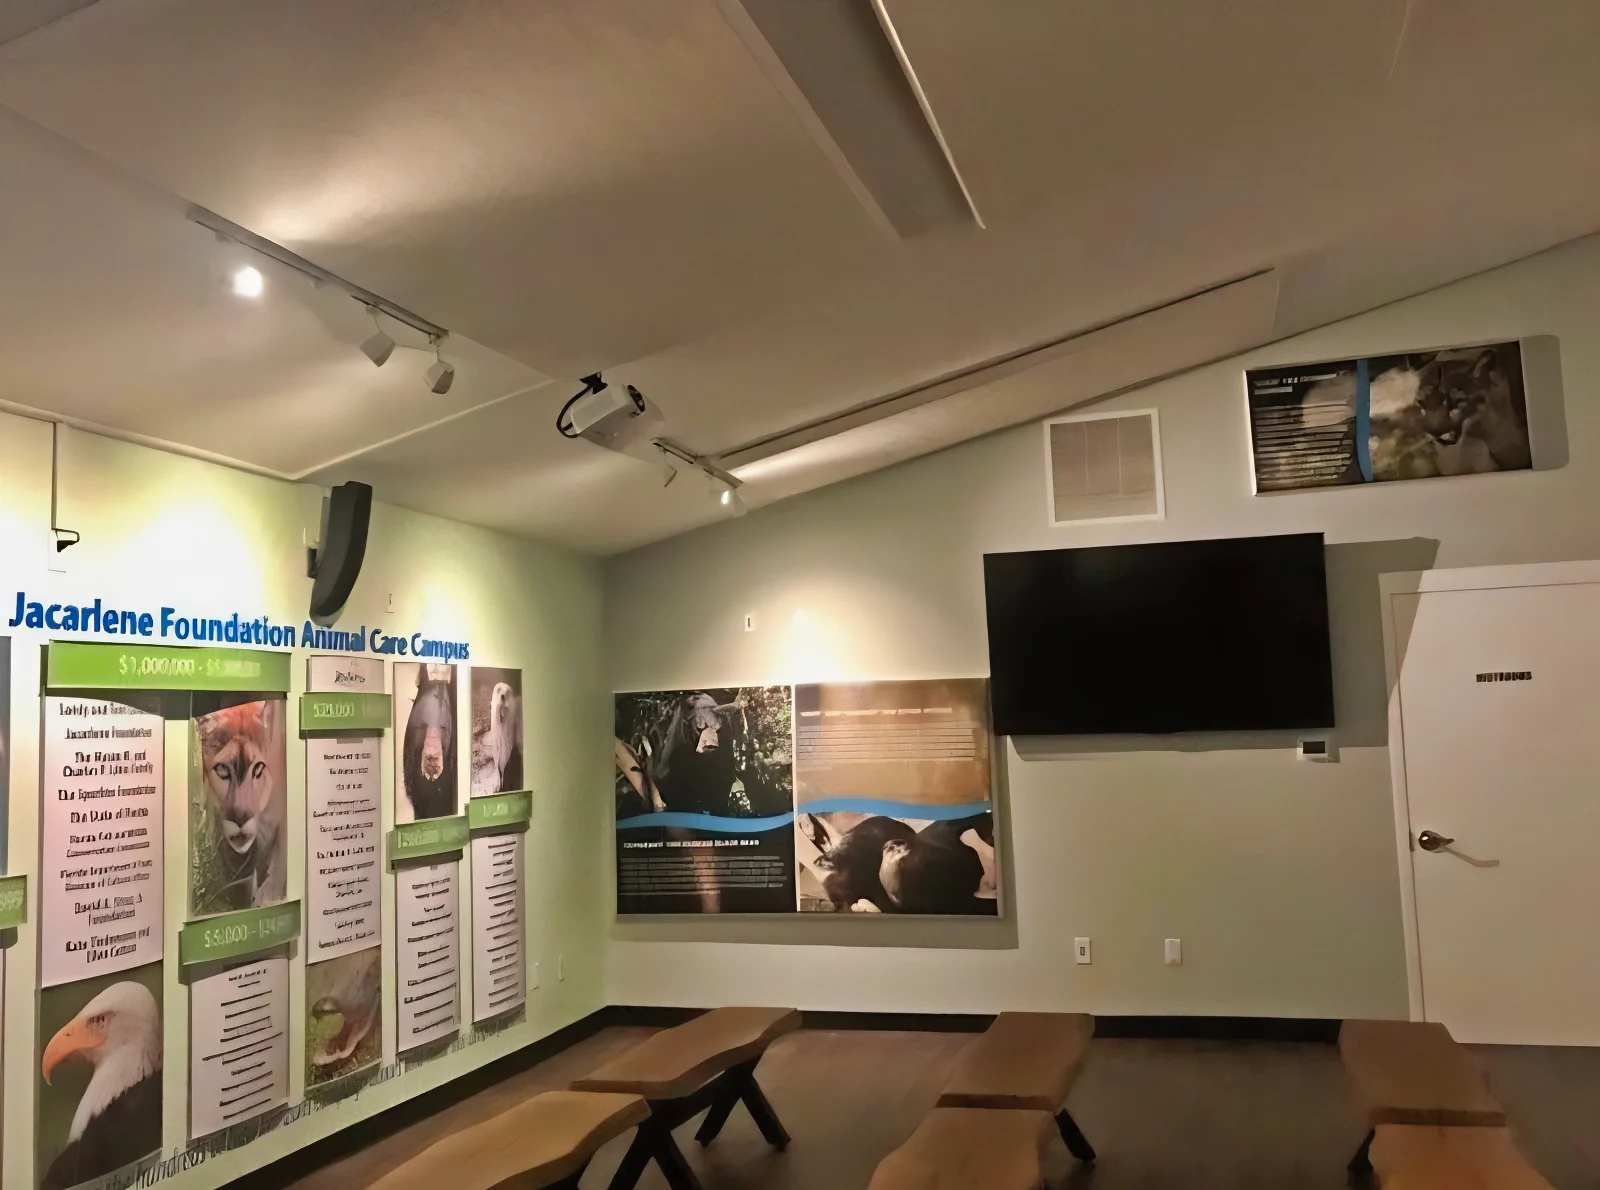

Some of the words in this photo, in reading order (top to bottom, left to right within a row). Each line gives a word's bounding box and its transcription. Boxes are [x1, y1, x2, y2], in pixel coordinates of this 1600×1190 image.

[9, 592, 153, 636] Jacarlene
[161, 607, 296, 647] Foundation
[302, 621, 365, 652] Animal
[370, 629, 408, 656] Care
[411, 632, 470, 663] Campus
